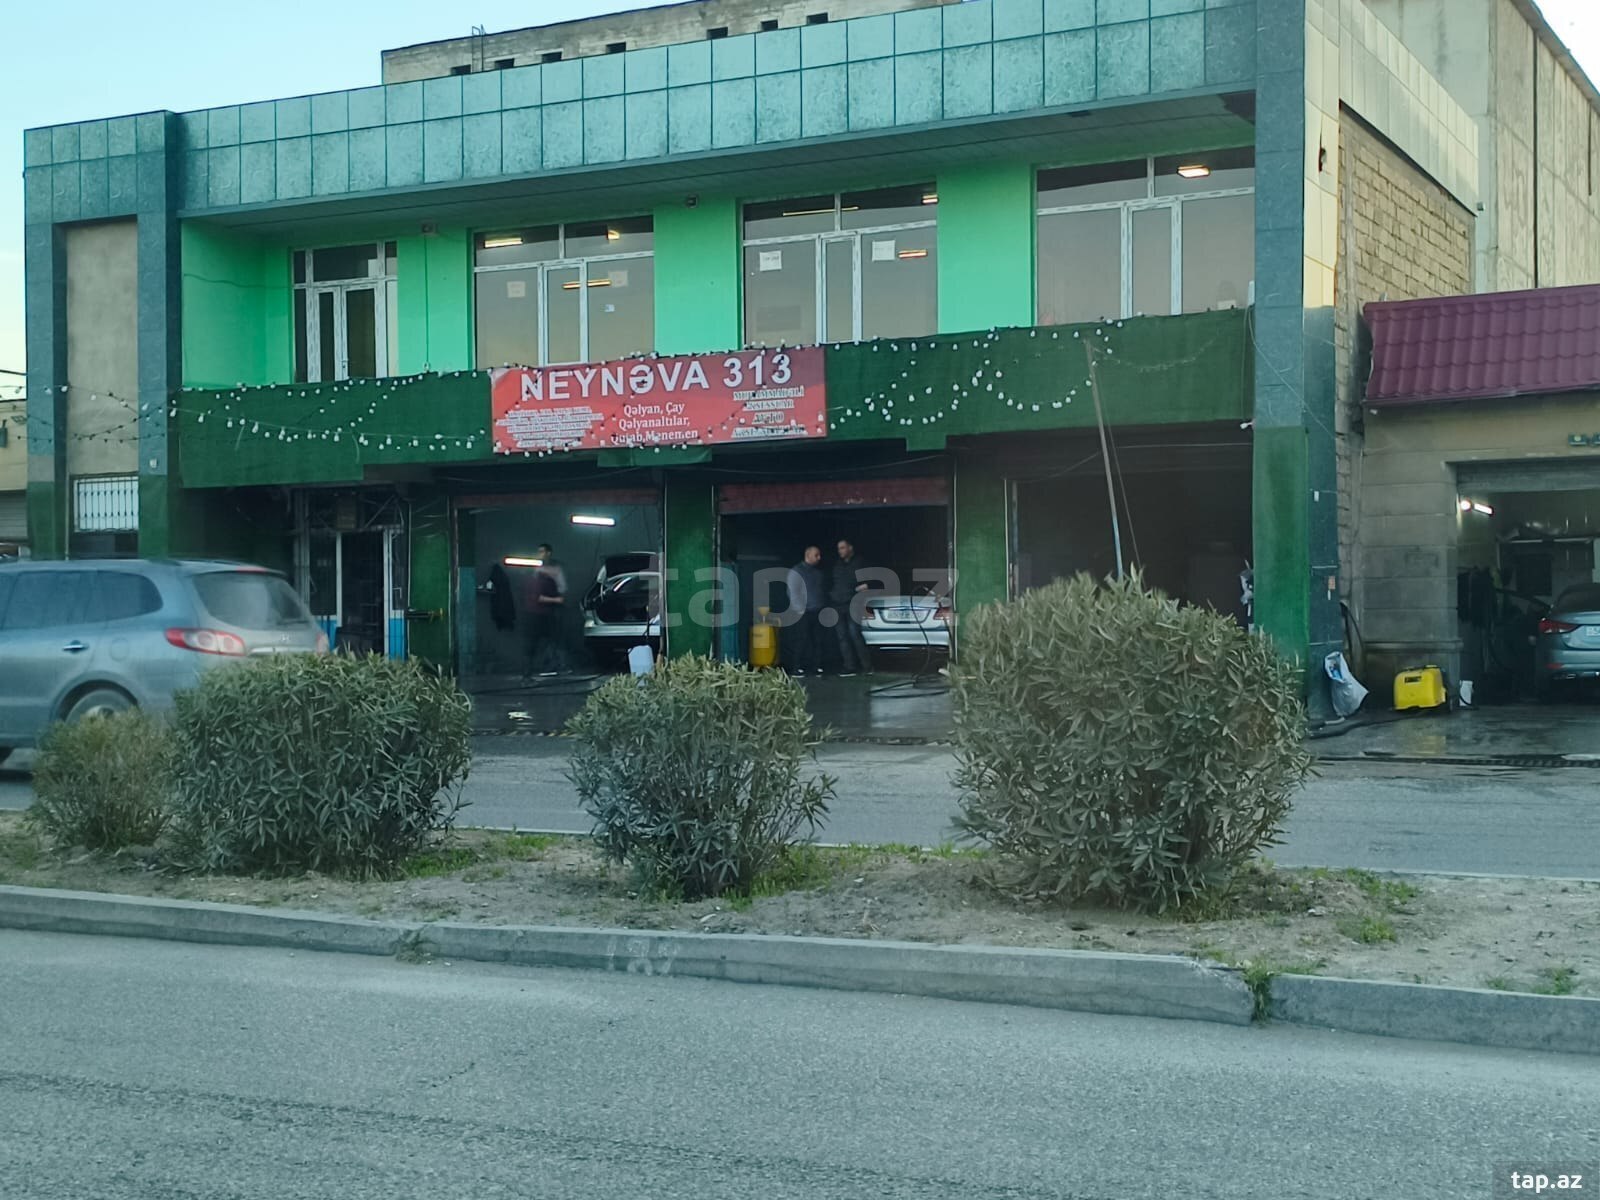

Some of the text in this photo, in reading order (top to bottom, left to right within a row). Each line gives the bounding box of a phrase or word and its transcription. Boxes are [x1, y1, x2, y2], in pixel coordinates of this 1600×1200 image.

[521, 353, 791, 401] NEYNƏVA 313
[624, 402, 685, 417] Qəlyan, Çay
